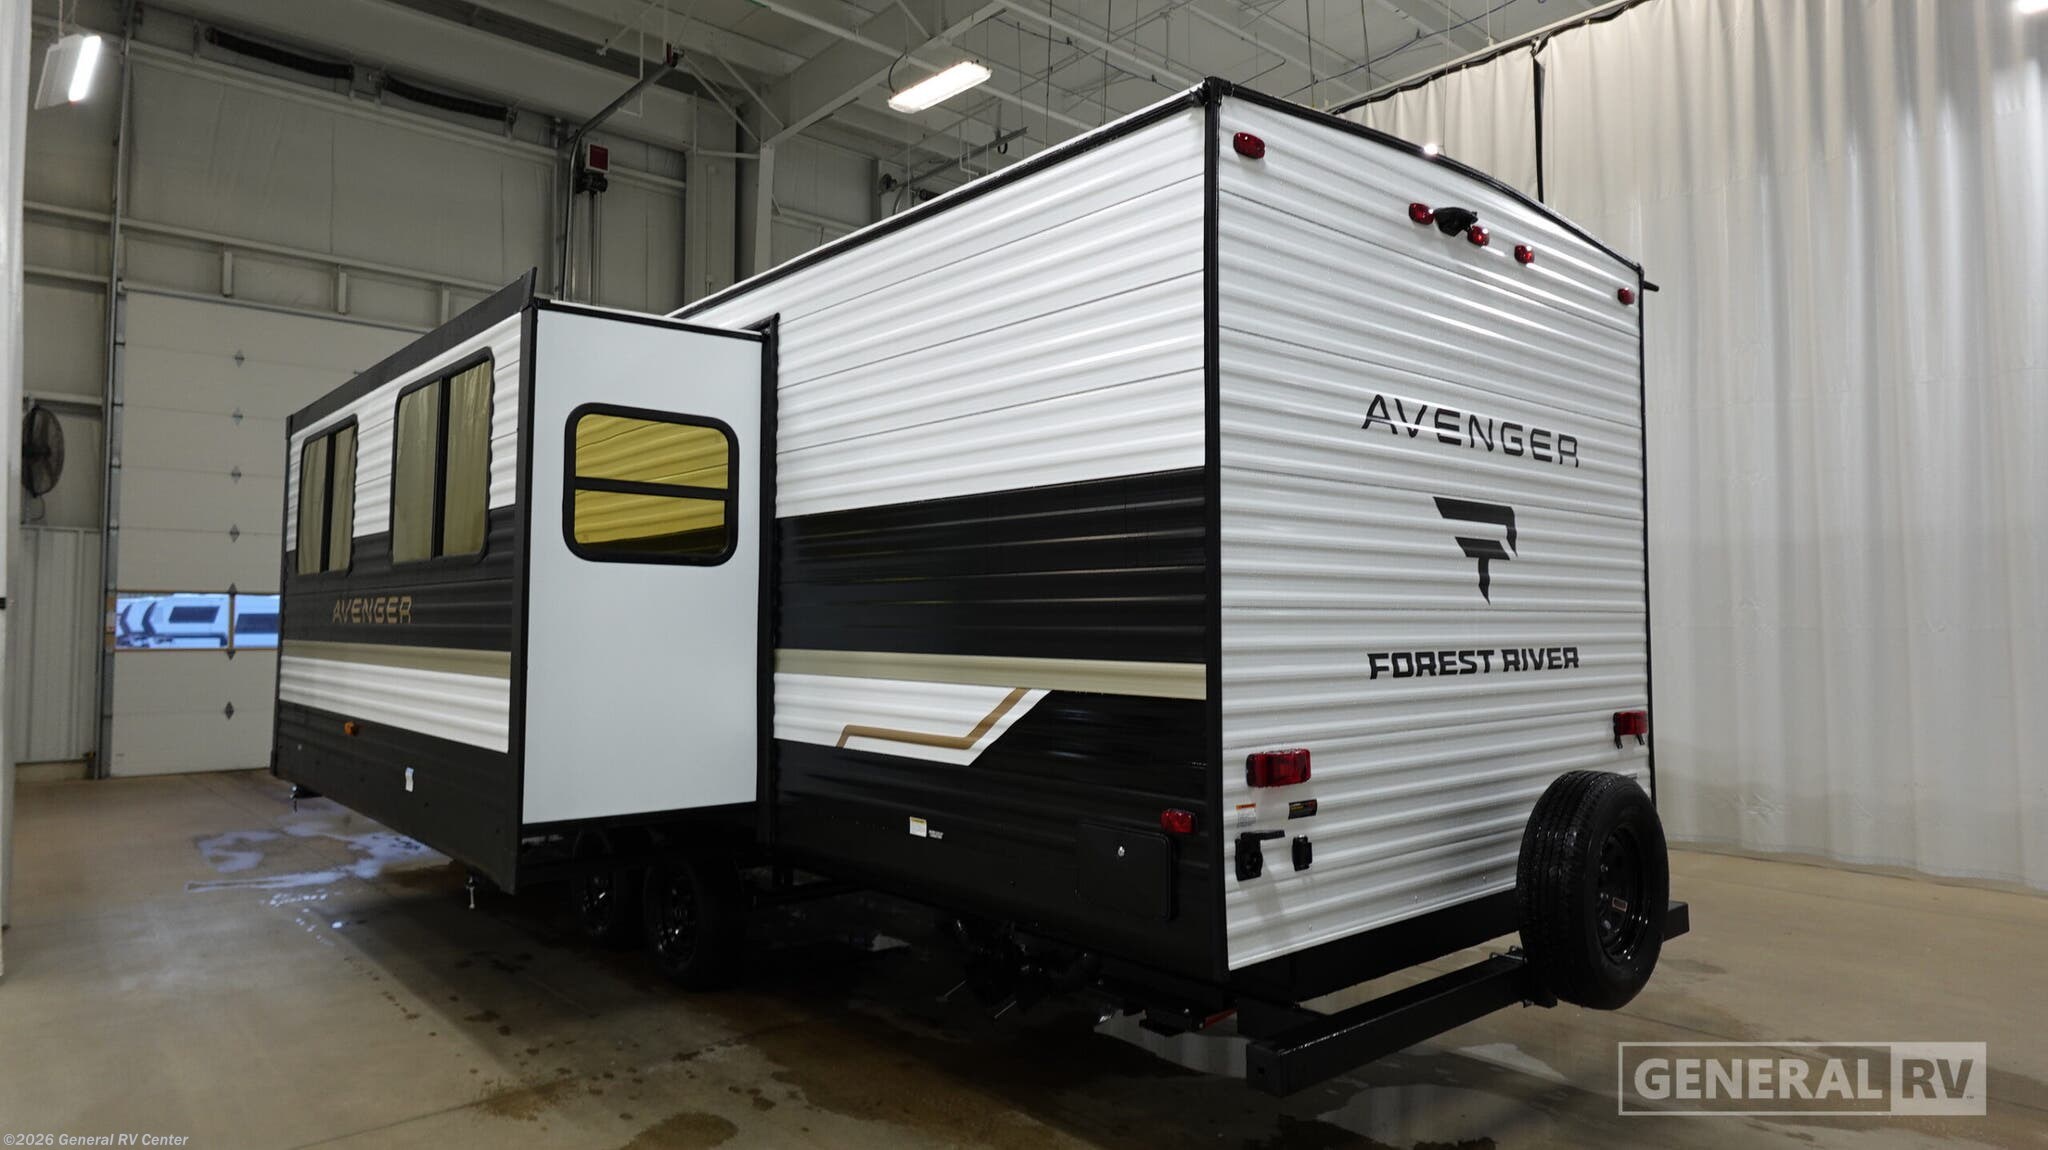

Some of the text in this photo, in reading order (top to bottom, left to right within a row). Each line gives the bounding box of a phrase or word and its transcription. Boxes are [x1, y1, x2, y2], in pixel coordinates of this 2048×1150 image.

[1361, 394, 1580, 468] AVENGER
[332, 595, 413, 624] AVENGER
[1367, 646, 1580, 680] FOREST RIVER
